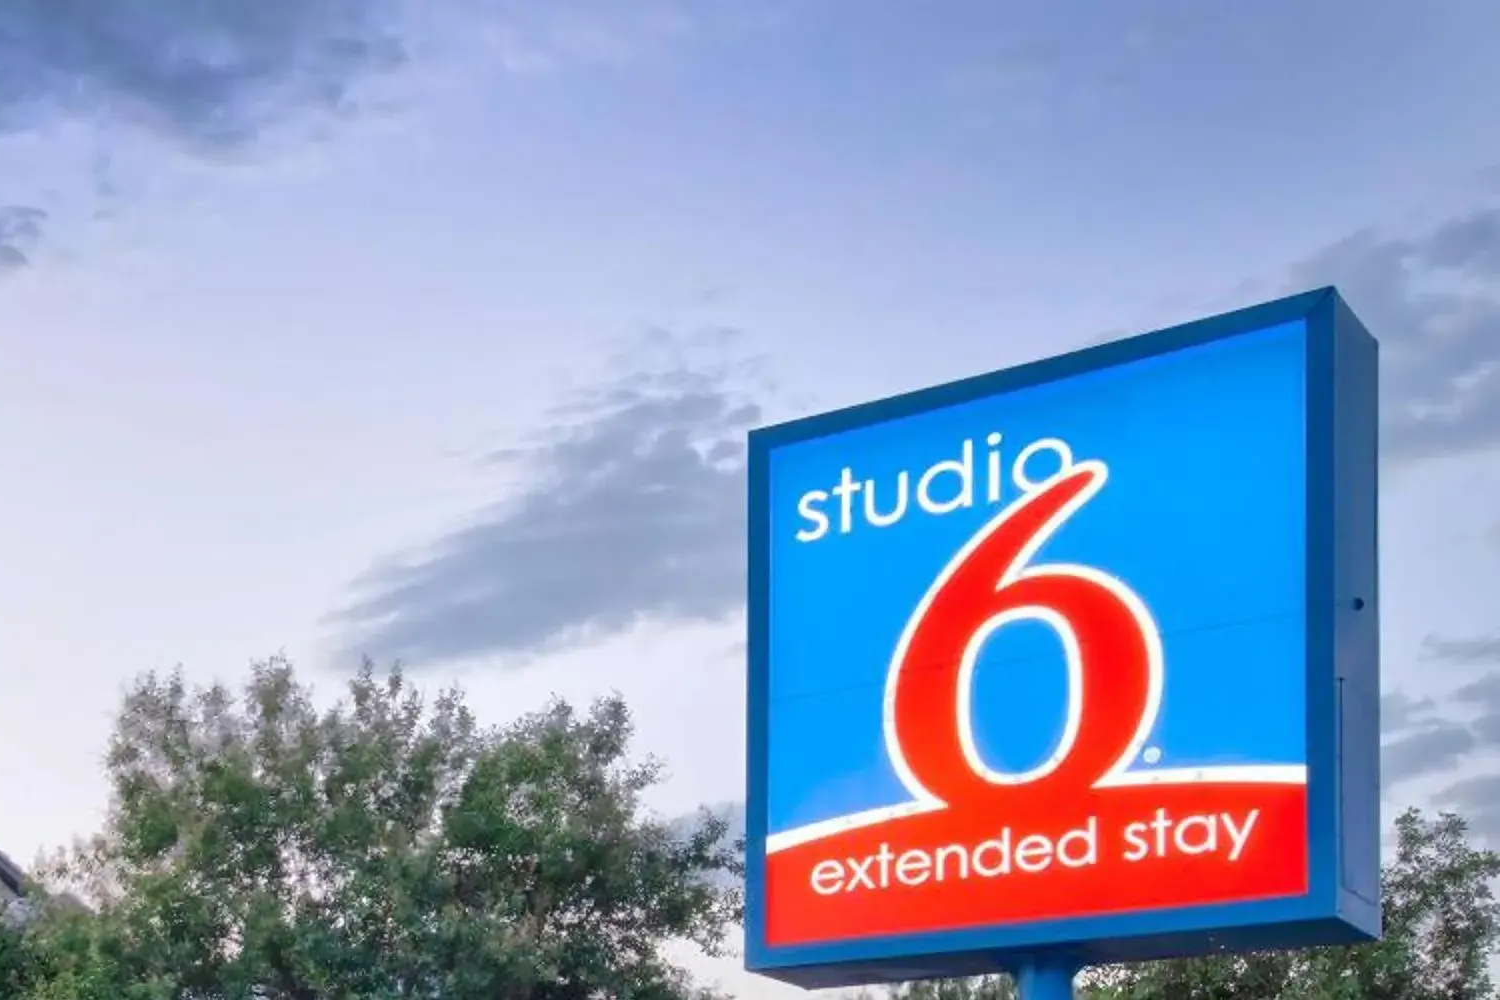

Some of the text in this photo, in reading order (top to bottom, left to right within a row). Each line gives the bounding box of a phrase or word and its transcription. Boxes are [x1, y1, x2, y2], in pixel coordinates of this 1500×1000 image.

[796, 432, 1073, 542] studio
[883, 459, 1163, 803] 6
[810, 808, 1260, 895] extended stay
